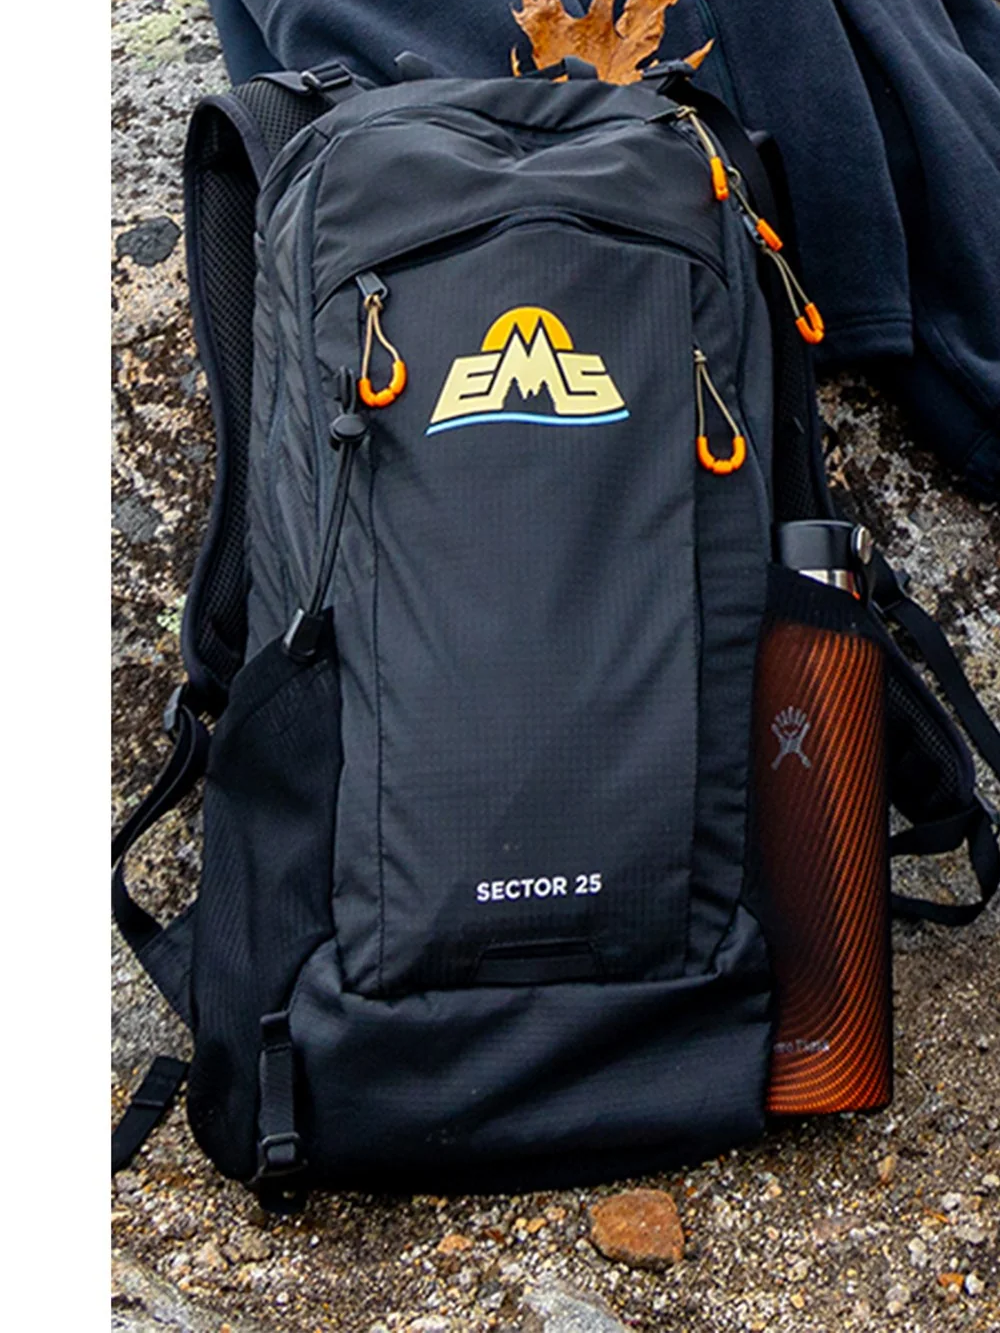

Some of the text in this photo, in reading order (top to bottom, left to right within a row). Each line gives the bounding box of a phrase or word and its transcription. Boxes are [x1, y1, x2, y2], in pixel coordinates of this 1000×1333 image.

[430, 327, 625, 424] EMS
[476, 873, 602, 901] SECTOR 25
